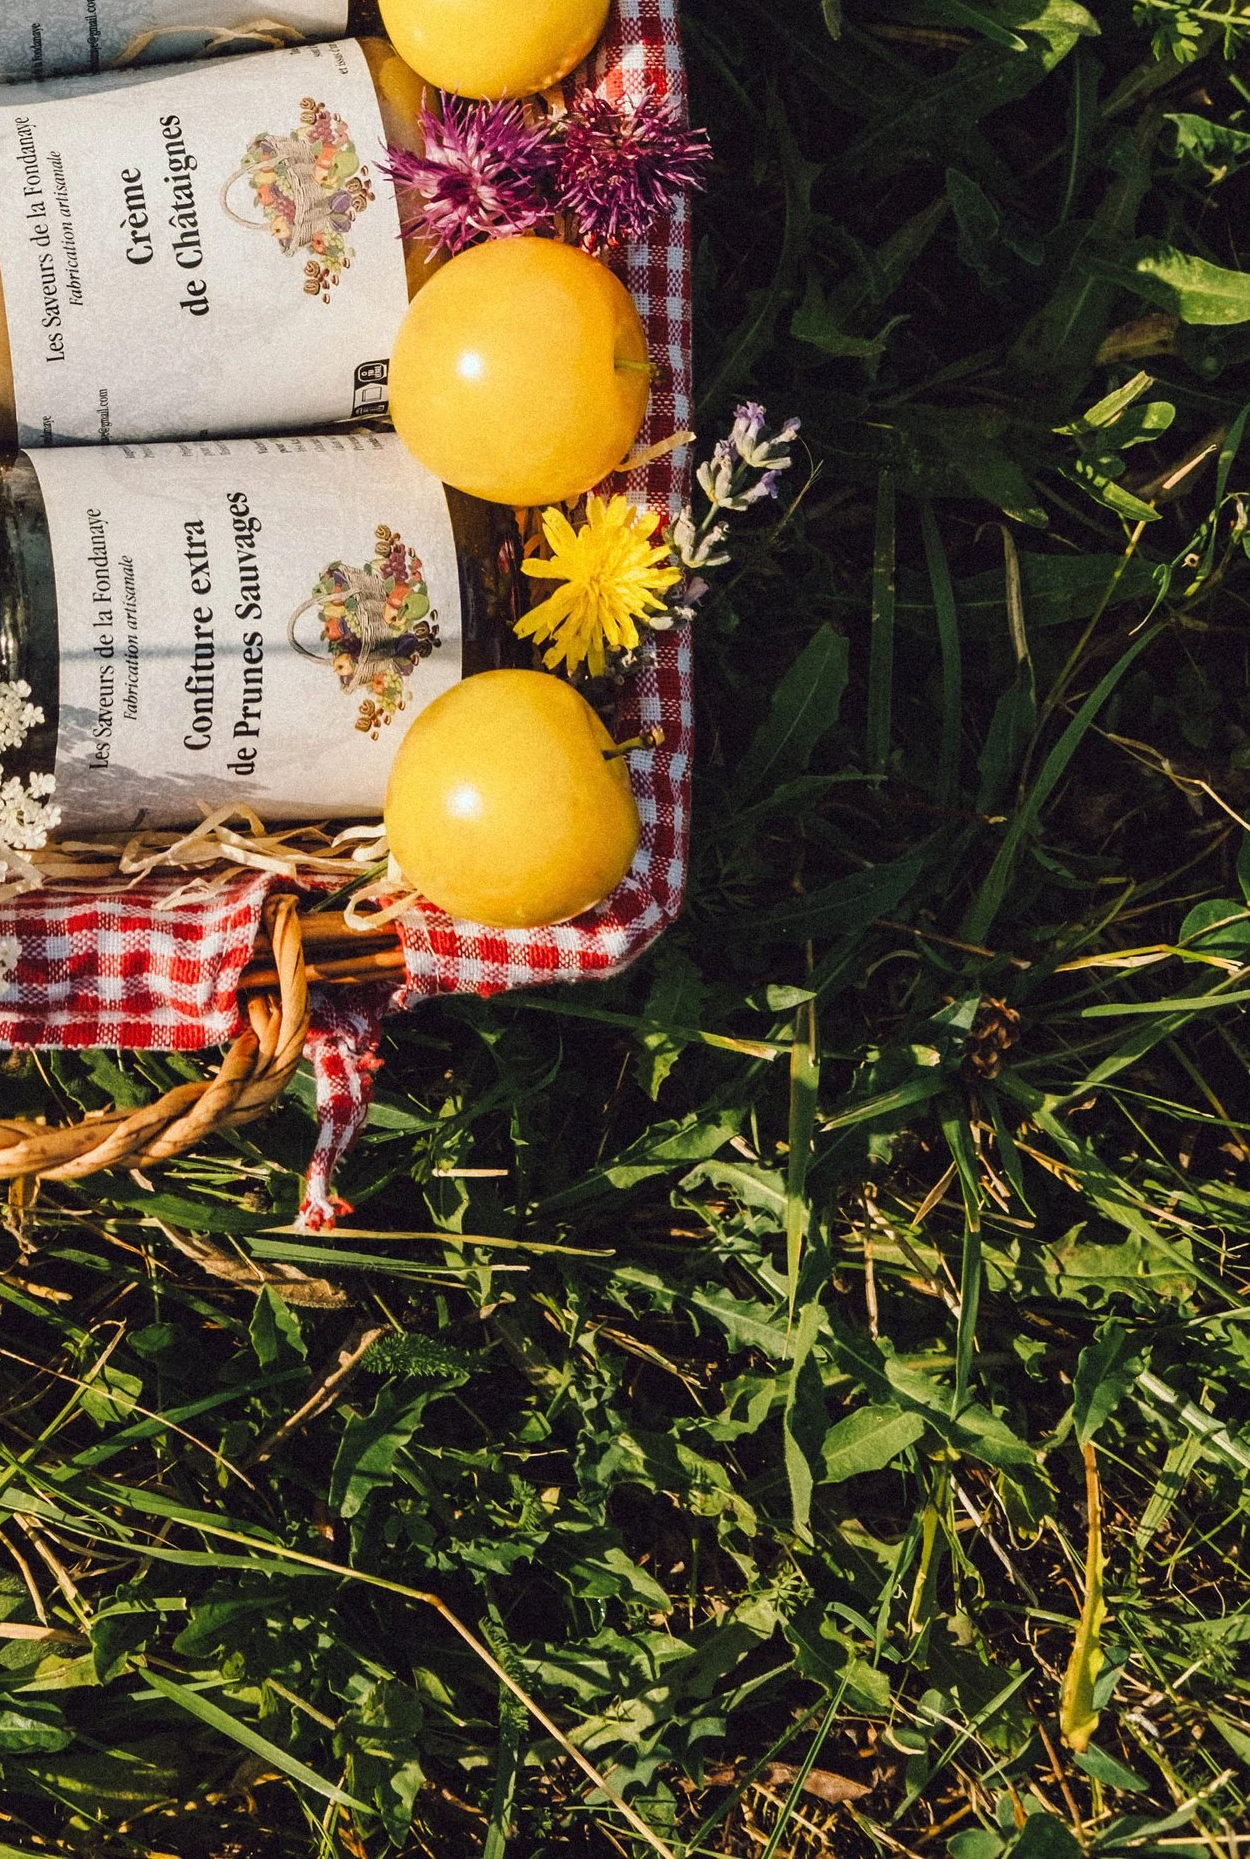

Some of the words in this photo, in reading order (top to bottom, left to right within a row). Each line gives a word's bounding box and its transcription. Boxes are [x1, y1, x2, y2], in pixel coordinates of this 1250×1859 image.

[13, 116, 43, 196] Fondanaye
[46, 150, 71, 218] artisanale
[158, 114, 204, 269] Châtaignes
[26, 201, 46, 218] la
[29, 224, 51, 247] de
[119, 167, 154, 265] Crème
[37, 253, 62, 328] Saveurs
[62, 222, 83, 307] Fabrication
[179, 279, 210, 317] de
[45, 333, 65, 363] Les
[86, 508, 111, 603] Fondanaye
[119, 555, 138, 630] artisanale
[183, 520, 212, 595] extra
[226, 492, 263, 620] Sauvages
[93, 610, 113, 627] la
[93, 634, 114, 659] de
[92, 665, 114, 738] Saveurs
[123, 635, 139, 721] Fabrication
[183, 606, 215, 751] Confiture
[232, 631, 263, 738] Prunes
[89, 743, 111, 769] Les
[227, 747, 258, 776] de
